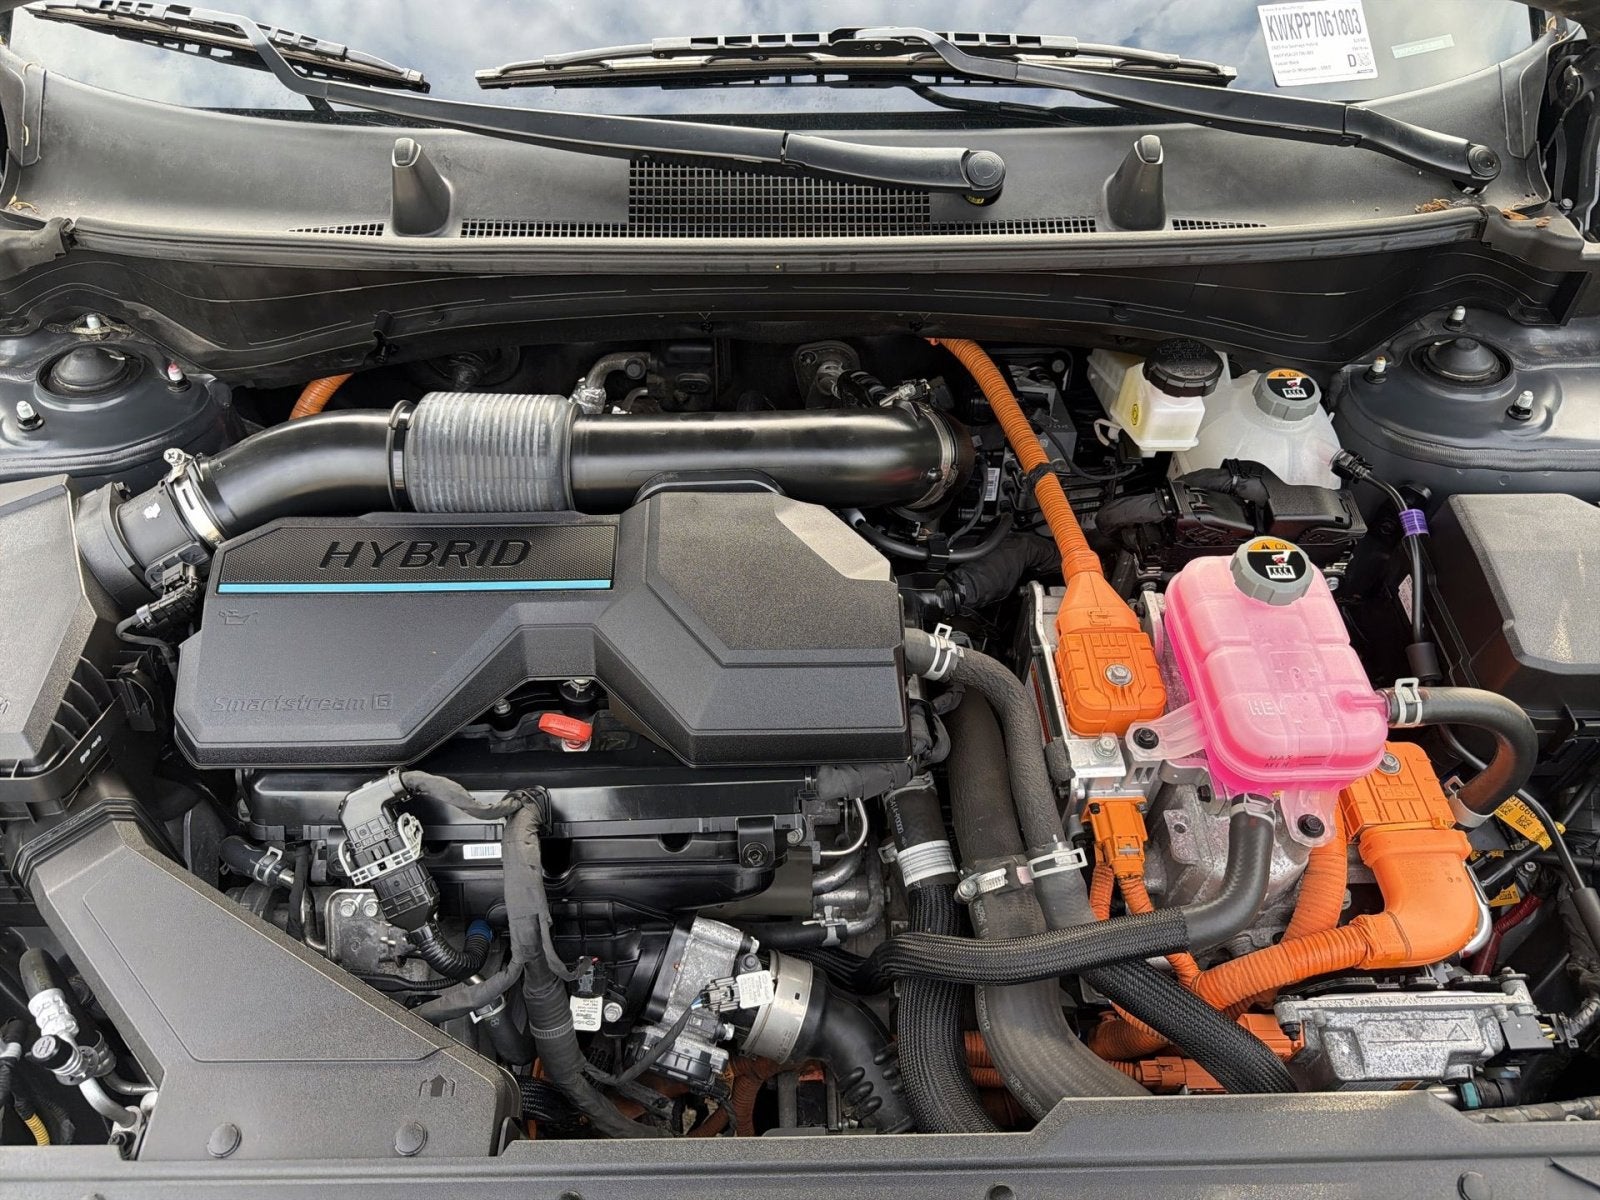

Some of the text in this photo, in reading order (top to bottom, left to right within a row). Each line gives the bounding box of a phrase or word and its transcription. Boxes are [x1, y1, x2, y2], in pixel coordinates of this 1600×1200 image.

[1265, 8, 1363, 42] KWKPP7061803
[1347, 54, 1357, 68] D
[318, 538, 533, 570] HYBRID
[211, 693, 368, 713] Smartstream
